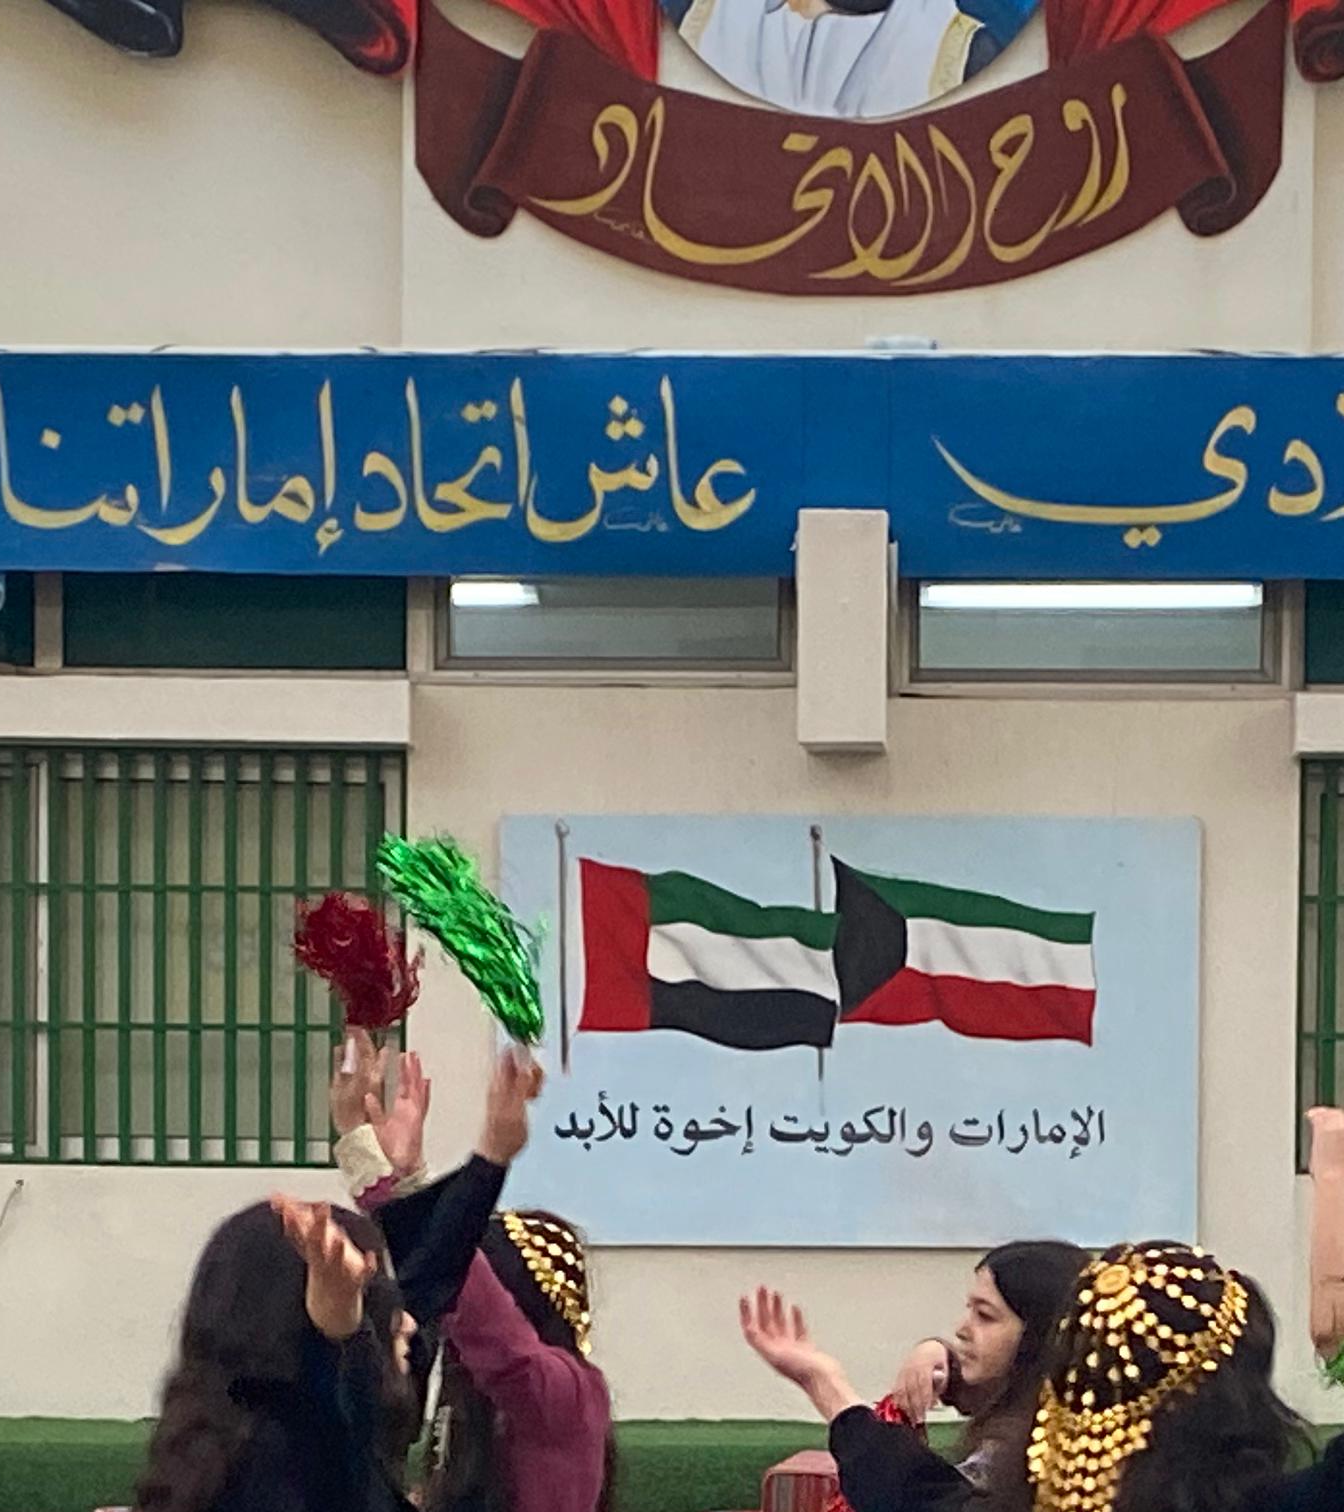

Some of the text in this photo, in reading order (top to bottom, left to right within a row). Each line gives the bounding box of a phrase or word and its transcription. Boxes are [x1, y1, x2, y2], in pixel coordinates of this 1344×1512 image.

[525, 82, 1130, 287] روح الاتحاد
[353, 376, 533, 532] اتحاد
[525, 374, 757, 543] عاش
[554, 1090, 1106, 1160] الإمارات والكويت إخوة للأبد
